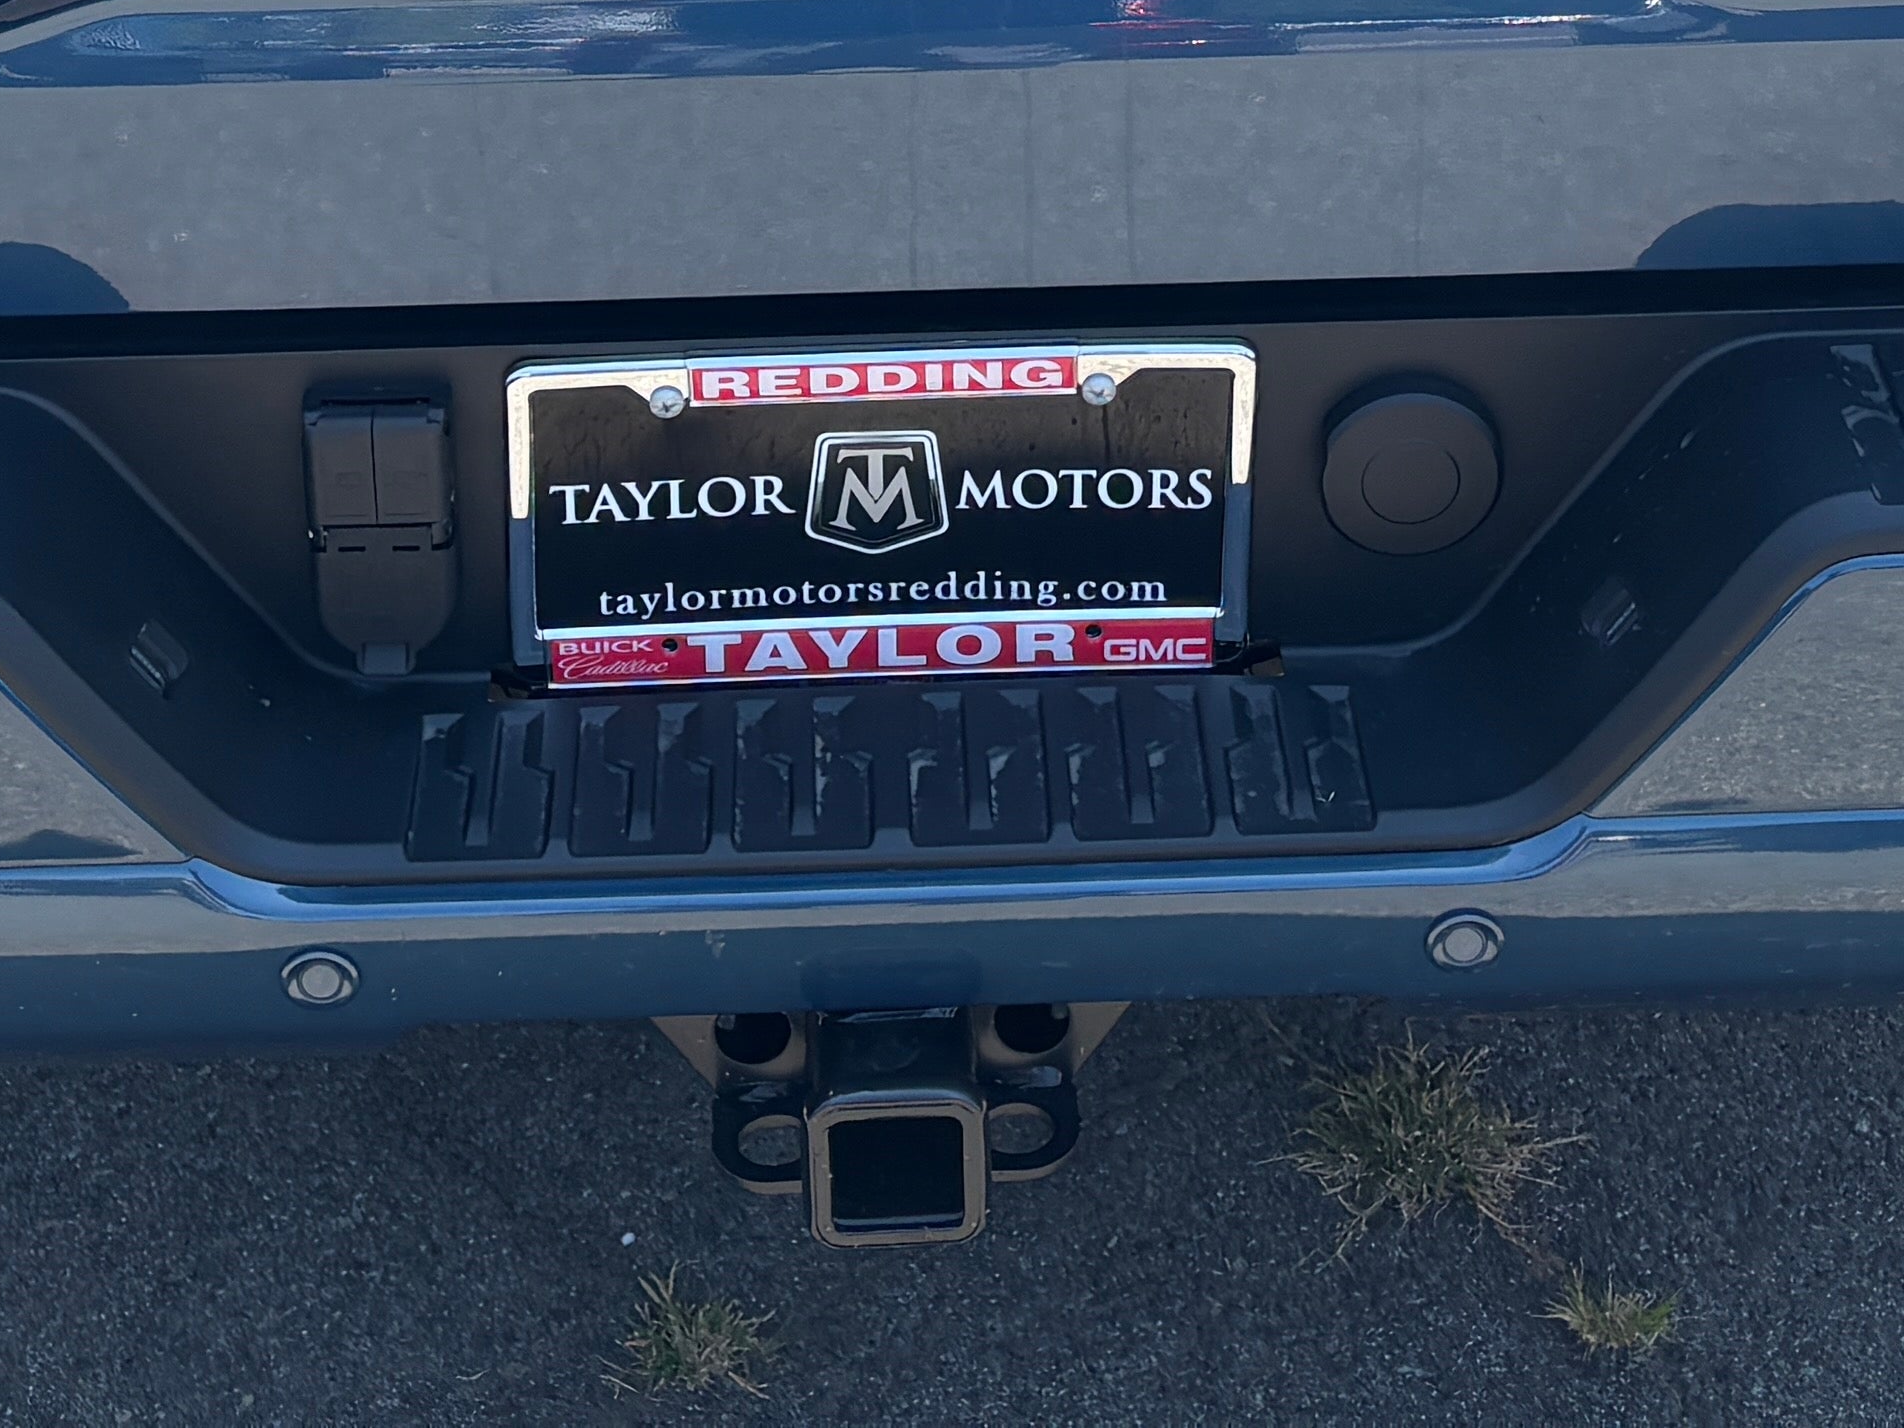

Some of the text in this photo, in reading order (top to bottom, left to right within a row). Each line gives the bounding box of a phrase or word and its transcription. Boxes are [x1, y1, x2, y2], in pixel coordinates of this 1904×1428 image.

[701, 358, 1066, 401] REDDING
[548, 474, 796, 527] TAYLOR
[955, 468, 1215, 513] MOTORS
[599, 570, 1169, 622] taylormotorsredding.com
[557, 637, 654, 657] BUICK
[686, 622, 1077, 674] TAYLOR
[1103, 637, 1208, 662] GMC
